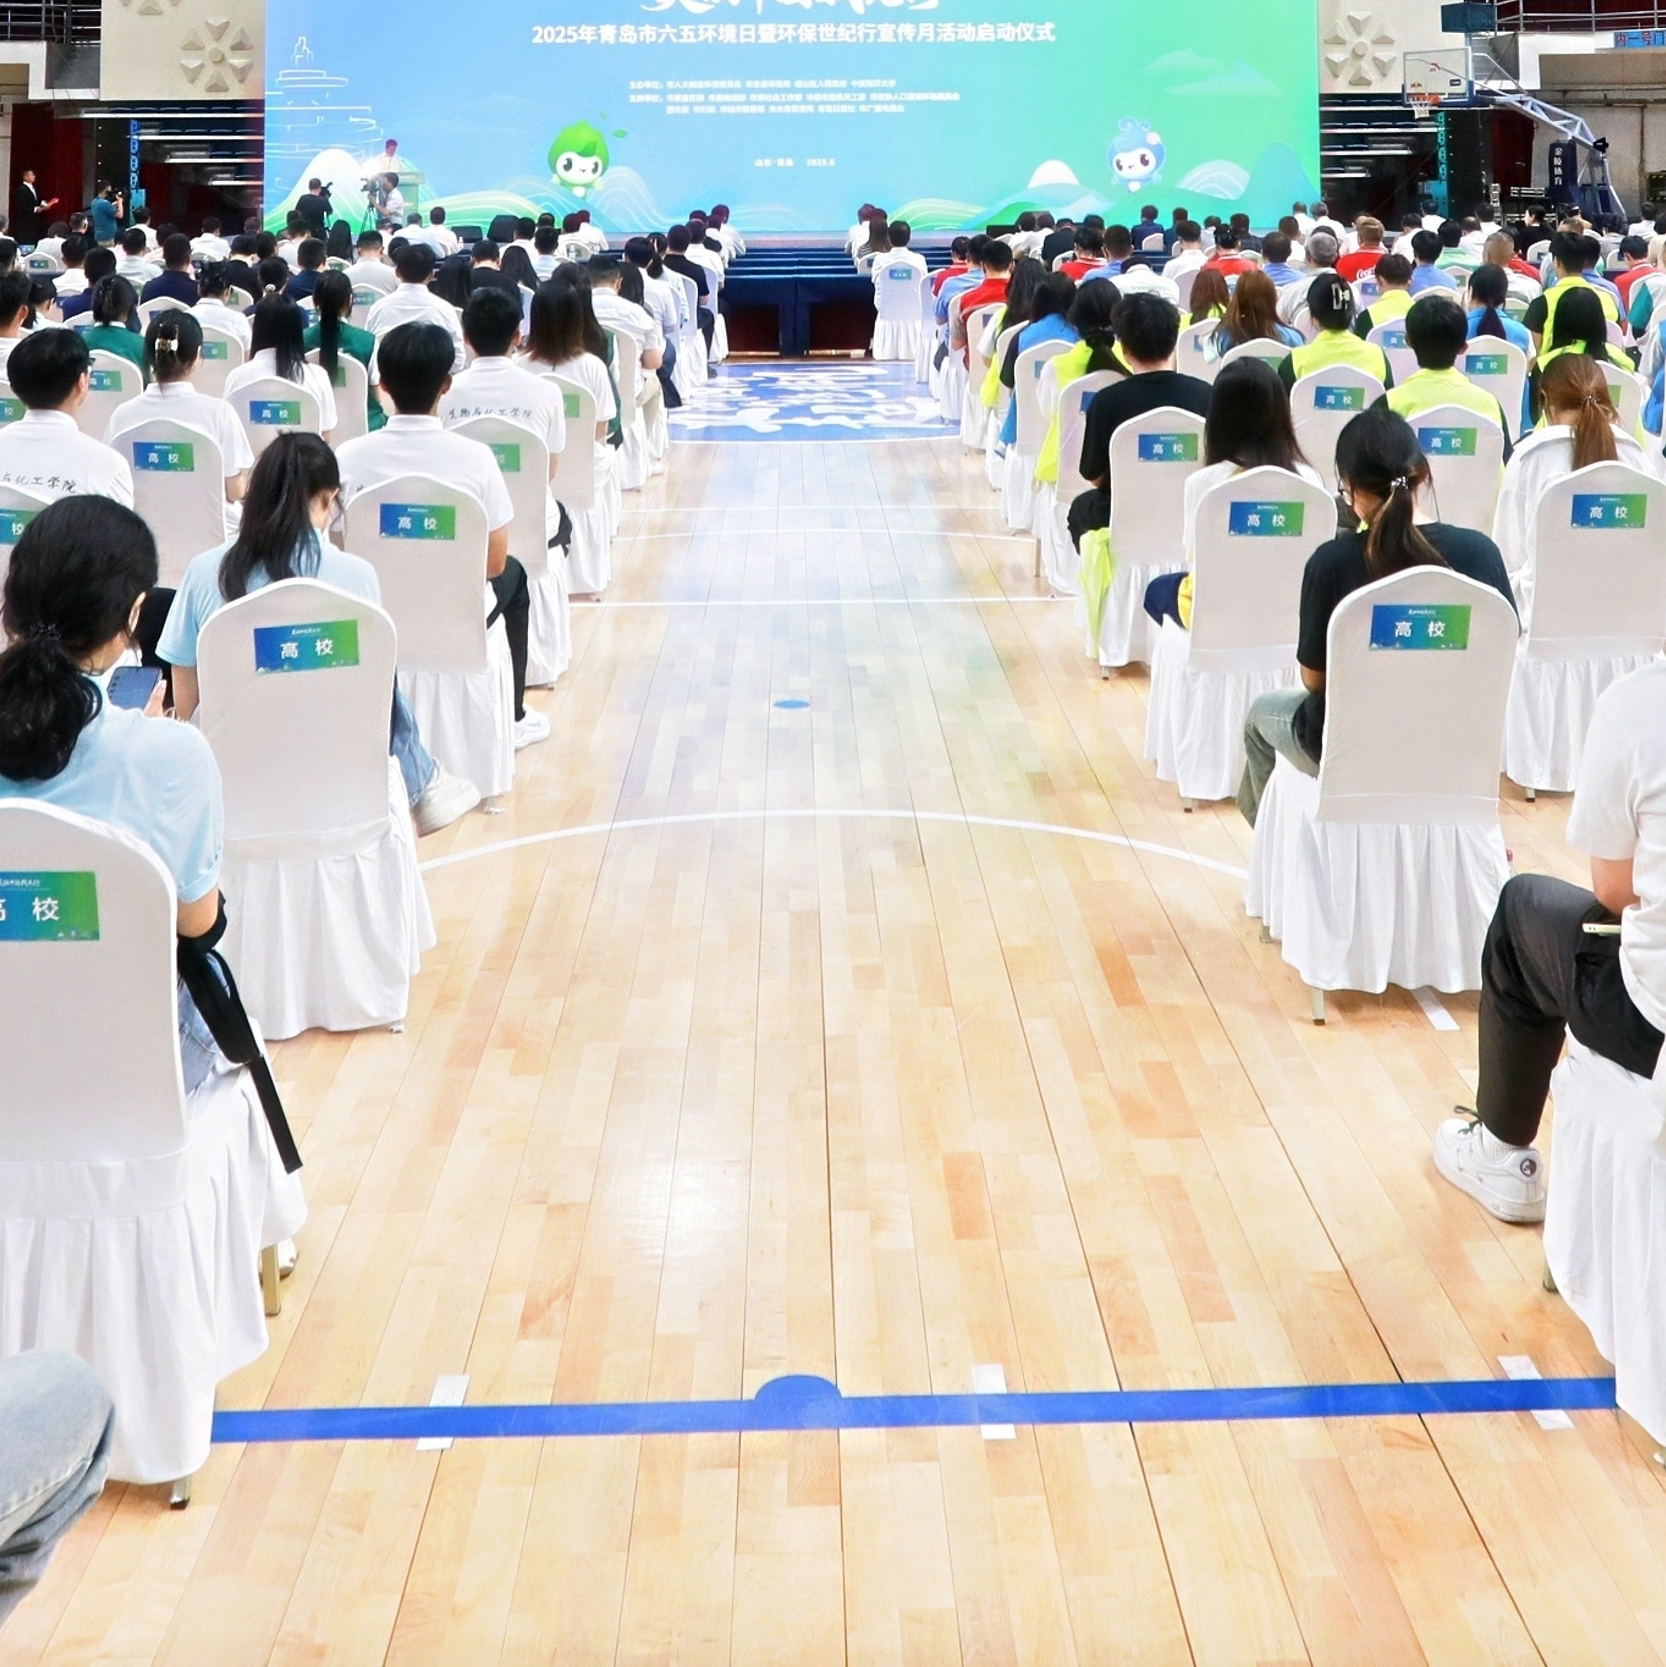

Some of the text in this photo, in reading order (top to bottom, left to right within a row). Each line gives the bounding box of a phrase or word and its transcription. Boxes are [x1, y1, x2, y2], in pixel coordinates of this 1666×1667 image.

[532, 21, 1056, 45] 2025年青岛市六五环境日暨环保世纪行宣传月活动启动仪式
[1476, 361, 1498, 371] 高校
[1327, 395, 1352, 405] 高校
[262, 409, 289, 420] 高校
[1153, 443, 1184, 454] 高校
[1431, 437, 1462, 448] 高校
[148, 453, 179, 464] 高校
[1589, 506, 1628, 520] 高校
[398, 516, 438, 531] 高校
[1247, 513, 1285, 528] 高校
[1394, 620, 1446, 639] 高校
[281, 639, 334, 659] 高校
